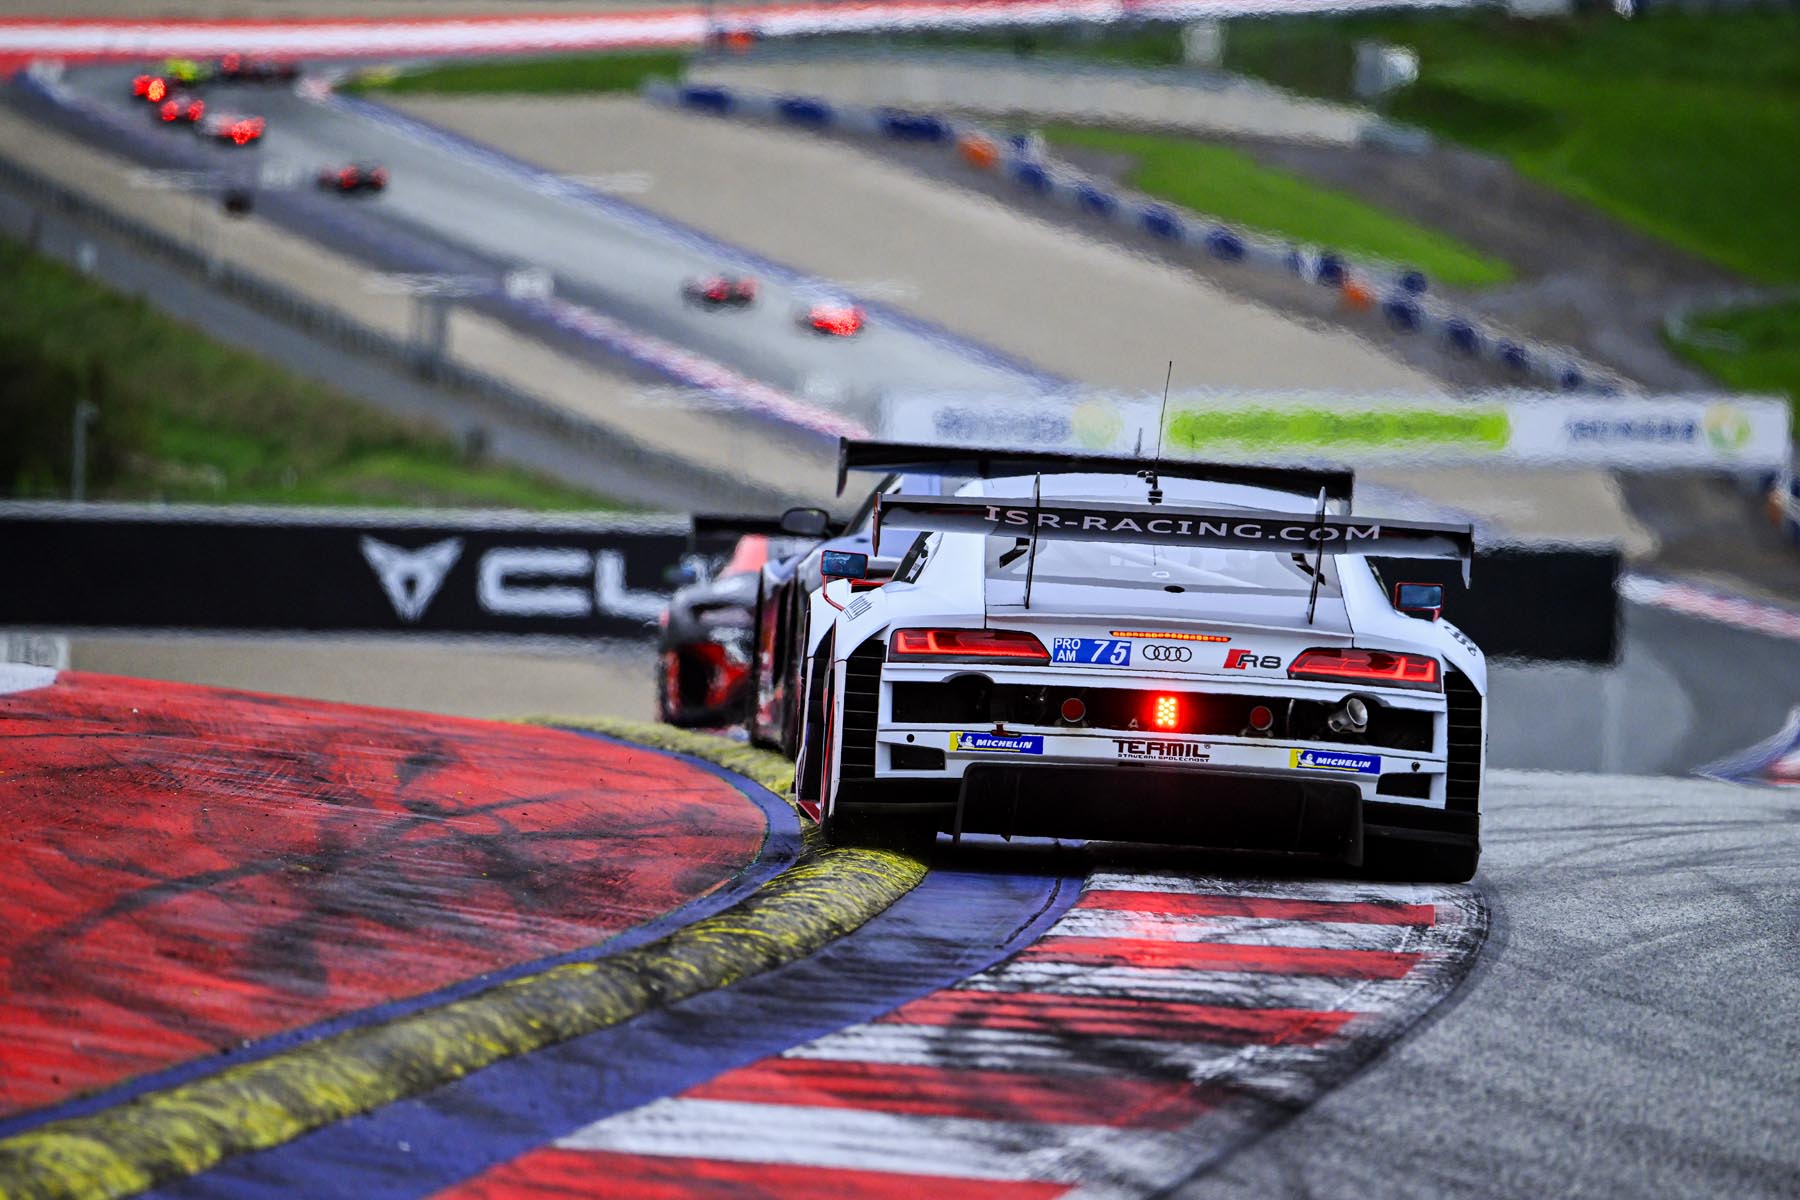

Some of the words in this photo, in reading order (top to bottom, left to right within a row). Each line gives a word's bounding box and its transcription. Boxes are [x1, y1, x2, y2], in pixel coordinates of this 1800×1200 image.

[984, 505, 1381, 541] ISR-RACING.COM
[1054, 639, 1082, 650] PRO
[1056, 650, 1077, 662] AM
[1090, 640, 1131, 665] 75
[1236, 654, 1282, 669] R8
[975, 739, 1033, 749] MICHELIN
[1315, 757, 1372, 768] MICHELIN
